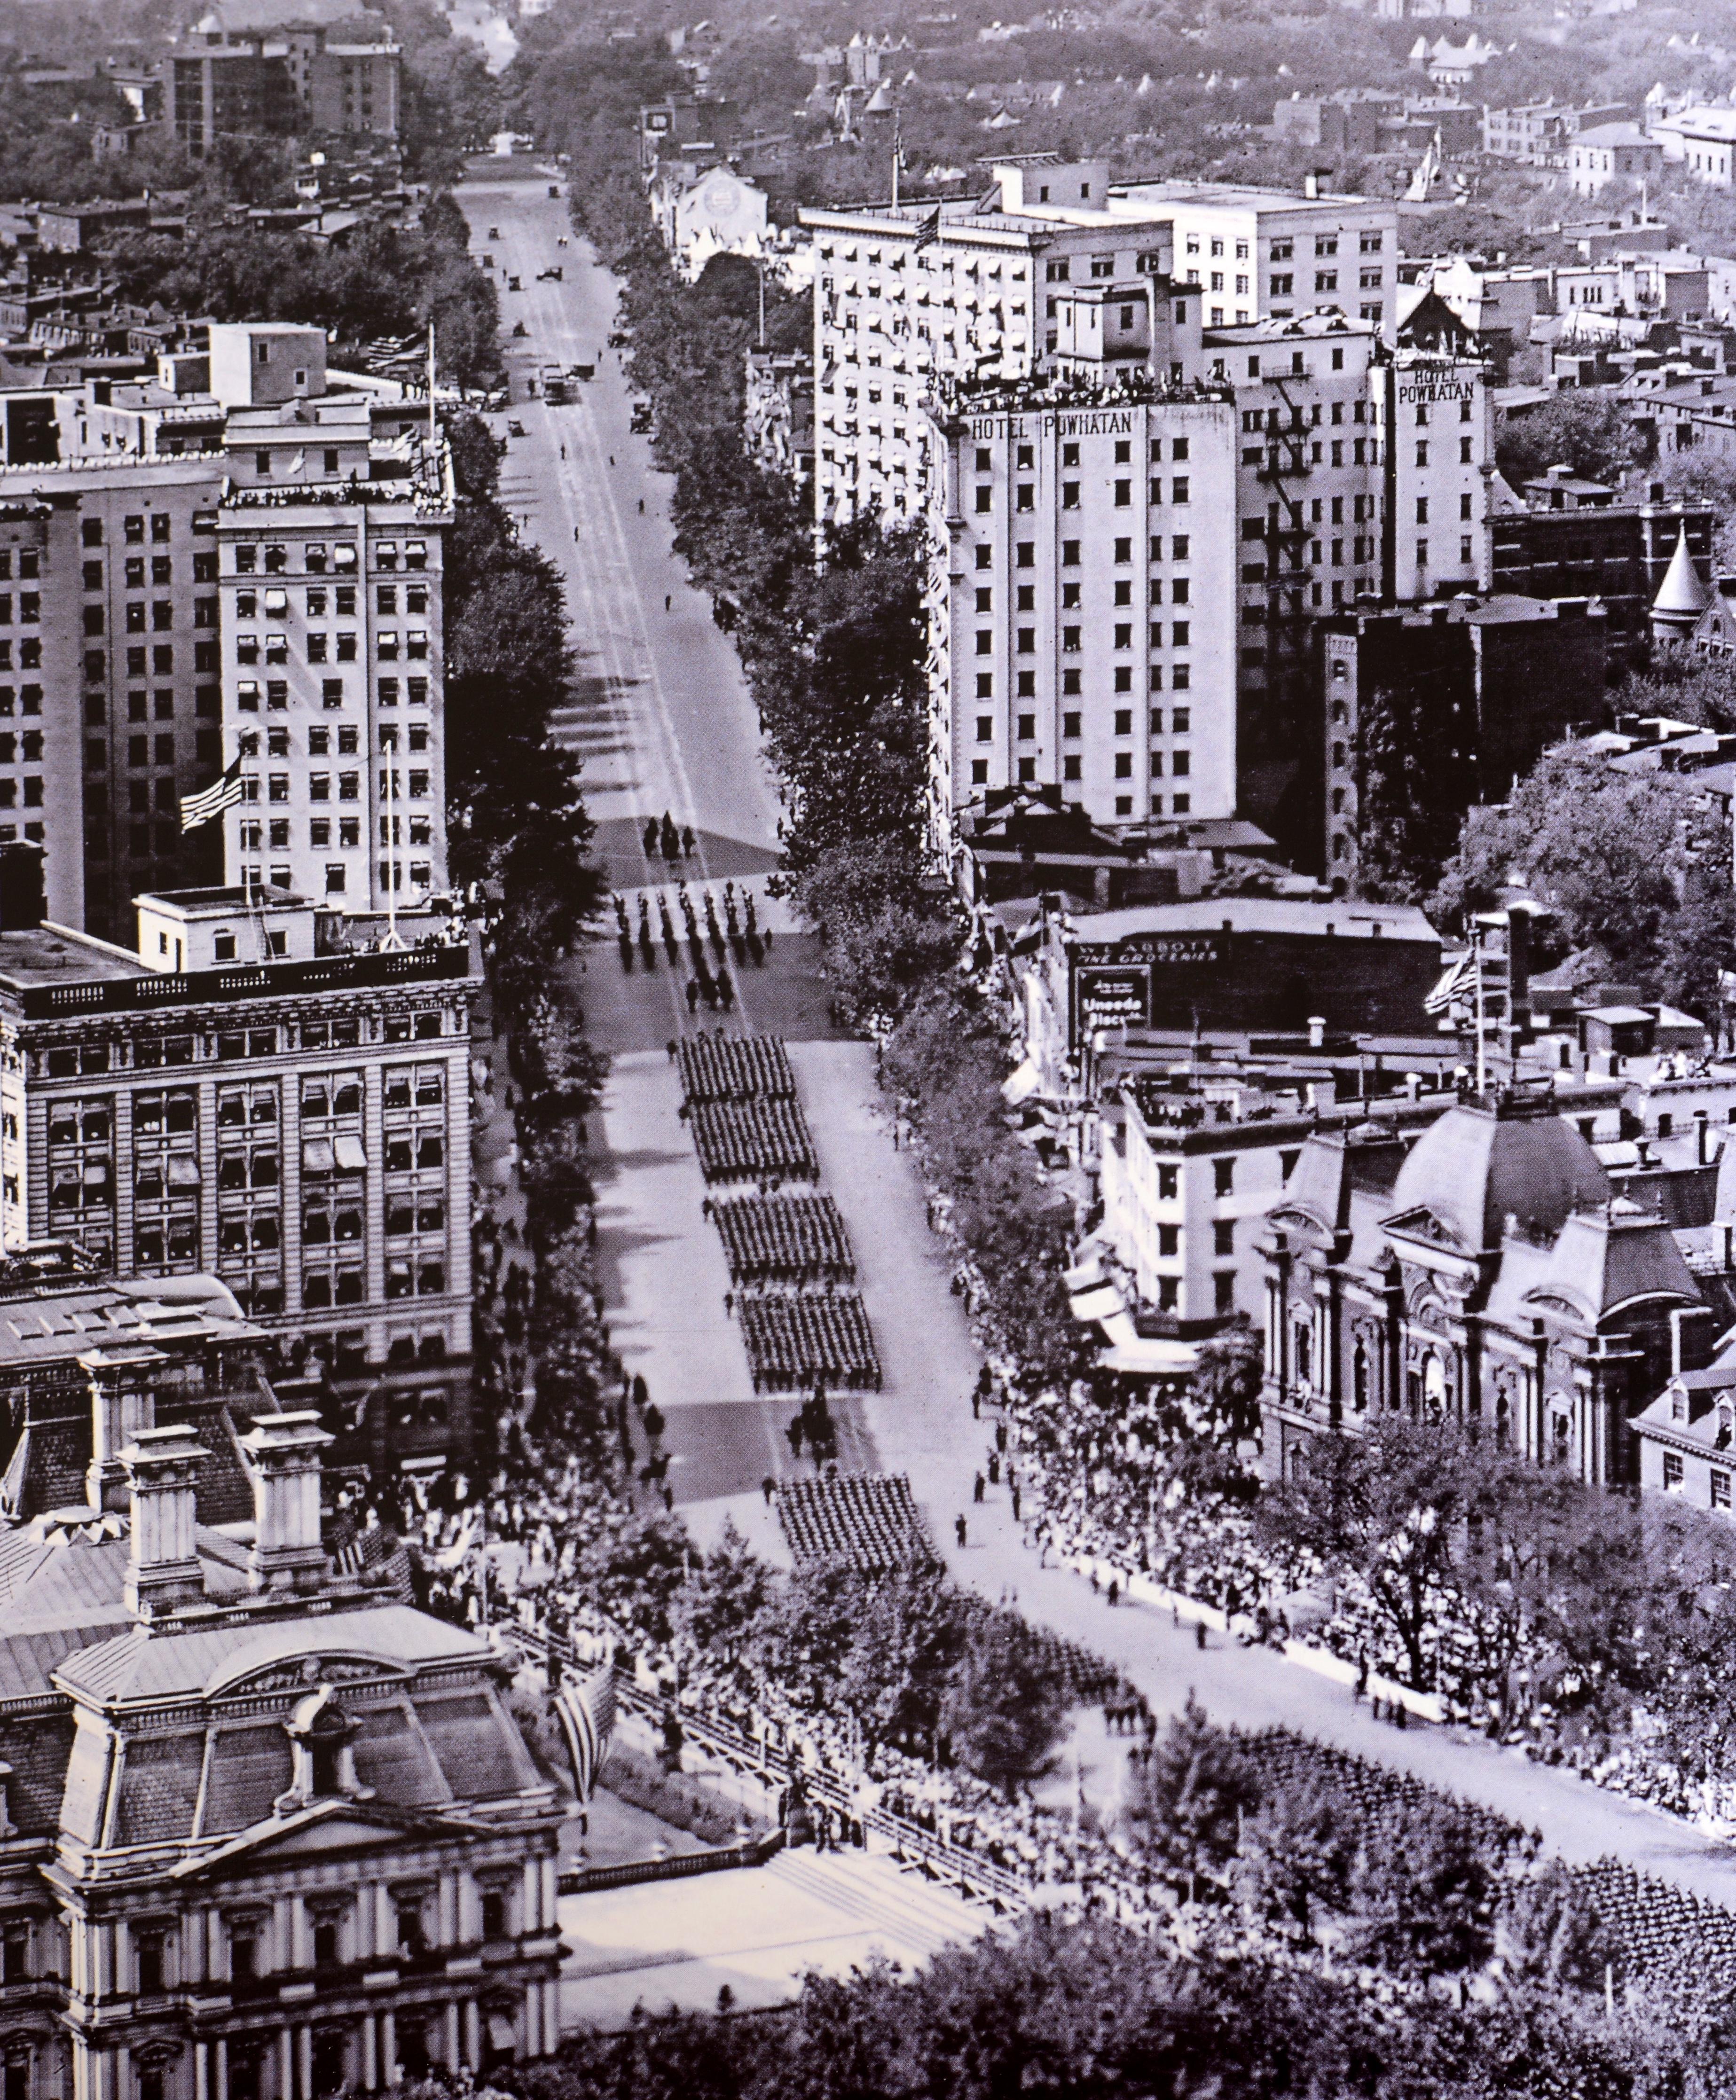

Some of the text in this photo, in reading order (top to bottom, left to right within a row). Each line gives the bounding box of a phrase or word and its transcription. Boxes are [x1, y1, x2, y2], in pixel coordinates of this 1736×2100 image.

[1415, 368, 1459, 384] HOTEL
[1399, 382, 1474, 404] POWHATAN
[972, 413, 1131, 440] HOTEL POWHATAN
